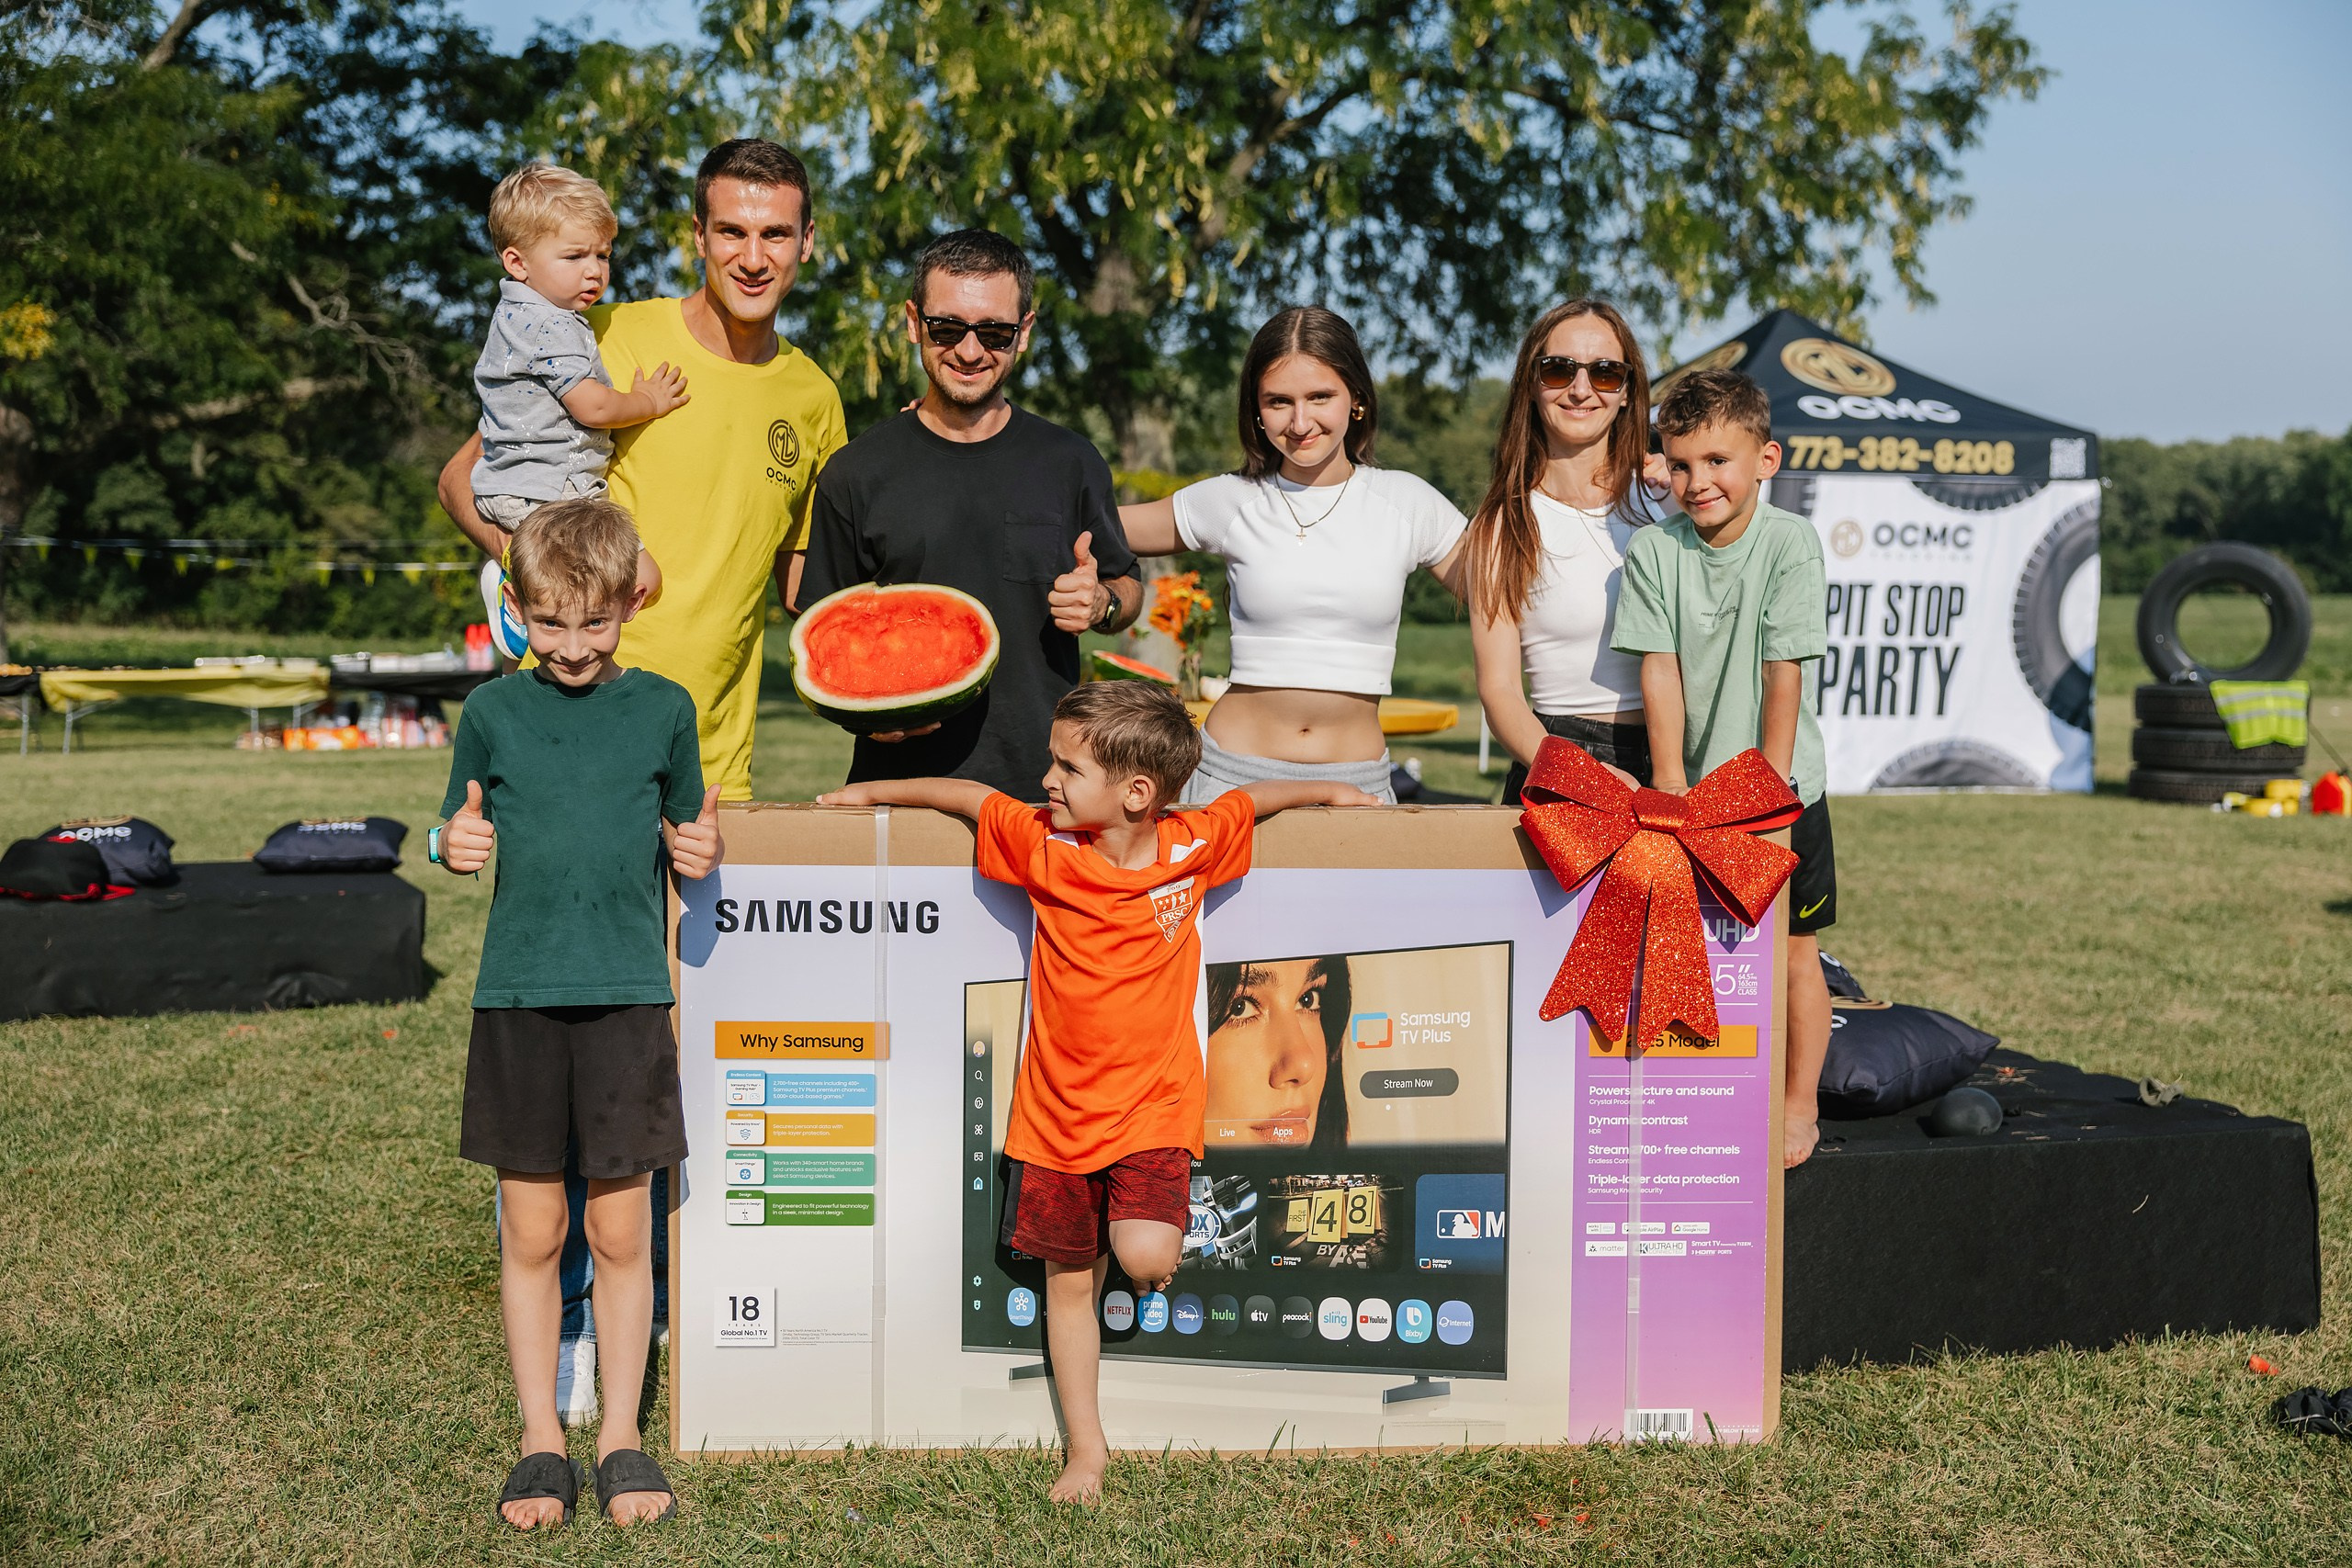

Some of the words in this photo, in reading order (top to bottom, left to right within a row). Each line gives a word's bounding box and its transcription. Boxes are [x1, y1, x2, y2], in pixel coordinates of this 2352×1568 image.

[1797, 395, 1961, 423] OCMC
[1787, 435, 2015, 476] 773-382-8208
[766, 467, 797, 491] OCMC
[1874, 523, 1973, 548] OCMC
[1826, 583, 1873, 637] PIT
[1883, 583, 1965, 637] STOP
[1816, 646, 1961, 716] PARTY
[715, 898, 940, 934] SAMSUNG
[1160, 908, 1188, 923] PRSC
[1400, 1010, 1471, 1029] Samsung
[1400, 1030, 1417, 1044] TV
[1421, 1028, 1452, 1043] Plus
[1626, 1034, 1664, 1047] 25
[1668, 1034, 1720, 1047] Model
[741, 1034, 779, 1052] Why
[783, 1034, 864, 1052] Samsung
[1384, 1077, 1413, 1089] Stream
[1415, 1077, 1433, 1089] Now
[1589, 1086, 1630, 1095] Powers
[1634, 1085, 1673, 1096] icture
[1675, 1086, 1697, 1095] and
[1700, 1086, 1735, 1096] sound
[1641, 1115, 1688, 1125] contrast
[1219, 1128, 1235, 1137] Live
[1272, 1126, 1294, 1137] Apps
[1588, 1145, 1629, 1155] Stream
[1664, 1145, 1688, 1155] free
[1690, 1145, 1740, 1155] channels
[1588, 1174, 1650, 1187] Triple-laer
[1653, 1174, 1679, 1184] data
[1681, 1174, 1739, 1187] protection
[1588, 1187, 1619, 1195] Samsung
[1317, 1244, 1337, 1256] BY
[729, 1296, 760, 1321] 18
[1107, 1305, 1132, 1316] NETFLIX
[1143, 1300, 1164, 1311] prime
[1144, 1310, 1163, 1318] video
[1211, 1308, 1236, 1321] hulu
[1282, 1312, 1309, 1323] peacock
[1323, 1313, 1348, 1326] sling
[1369, 1315, 1388, 1324] YouTube
[1405, 1330, 1423, 1339] Bixby
